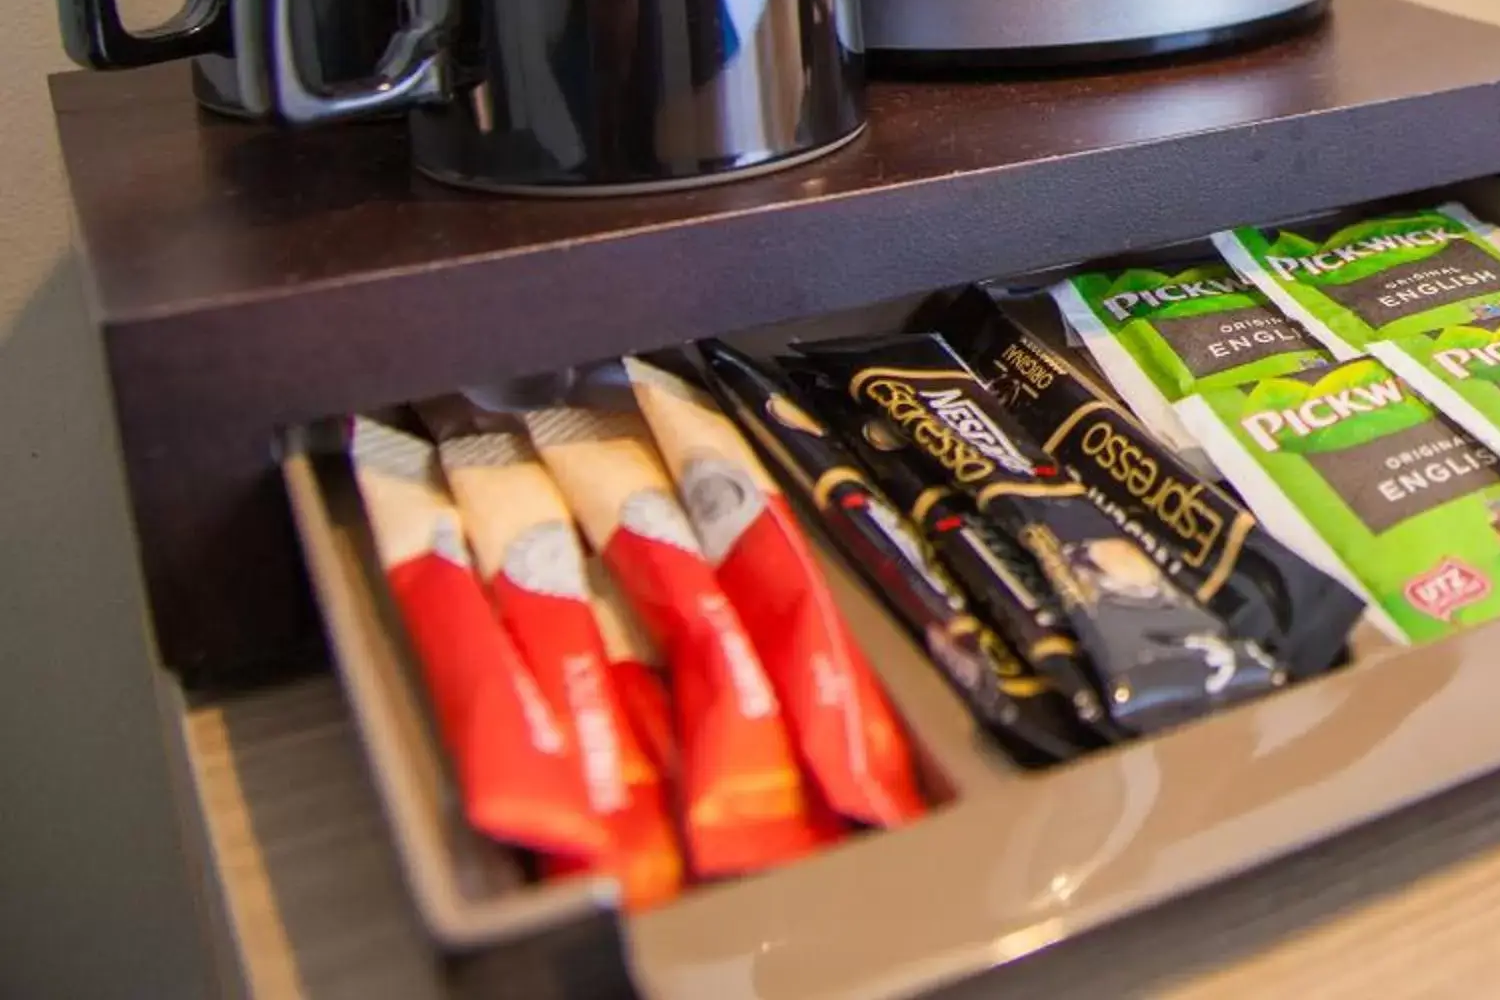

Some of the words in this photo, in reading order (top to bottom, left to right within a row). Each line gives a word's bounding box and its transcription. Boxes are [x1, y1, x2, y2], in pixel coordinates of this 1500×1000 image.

[1266, 227, 1464, 282] PICKWICK
[1384, 266, 1461, 290] ORIGINAL
[1377, 269, 1497, 309] ENGLISH
[1241, 378, 1403, 452] PICKW
[1081, 422, 1223, 568] Espresso
